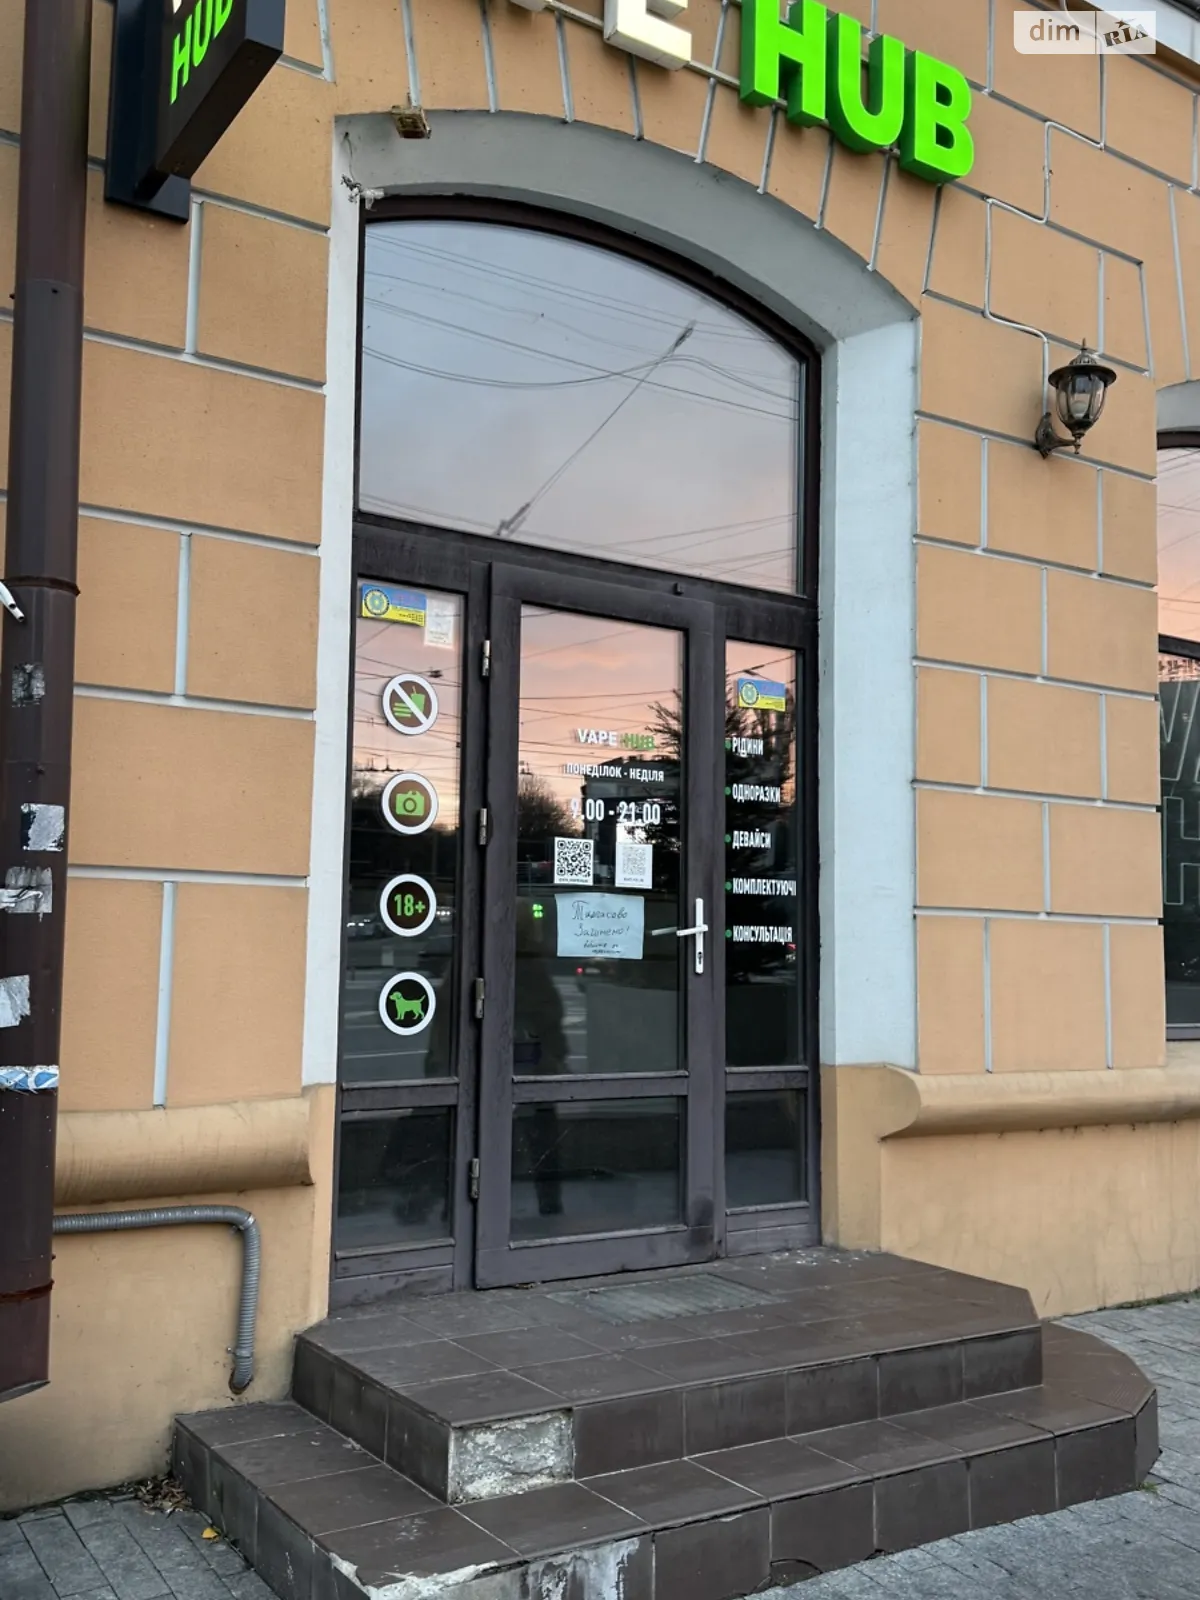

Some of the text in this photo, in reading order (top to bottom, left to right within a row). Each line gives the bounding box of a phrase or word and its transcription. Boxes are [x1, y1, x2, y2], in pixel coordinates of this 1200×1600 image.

[742, 0, 975, 182] HUB
[577, 728, 655, 751] VAPE HUB
[732, 737, 764, 757] РІДИНИ
[565, 762, 622, 778] ПОНЕДІЛОК
[629, 768, 665, 782] НЕДІЛЯ
[732, 784, 781, 803] ОДНОРАЗКИ
[570, 798, 605, 821] 9.00
[619, 801, 661, 825] 21.00
[732, 828, 772, 850] ДЕВАЙСИ
[732, 877, 797, 896] КОМПЛЕКТУЮЧІ
[394, 893, 426, 917] 18+
[732, 925, 793, 945] КОНСУЛЬТАЦІЯ
